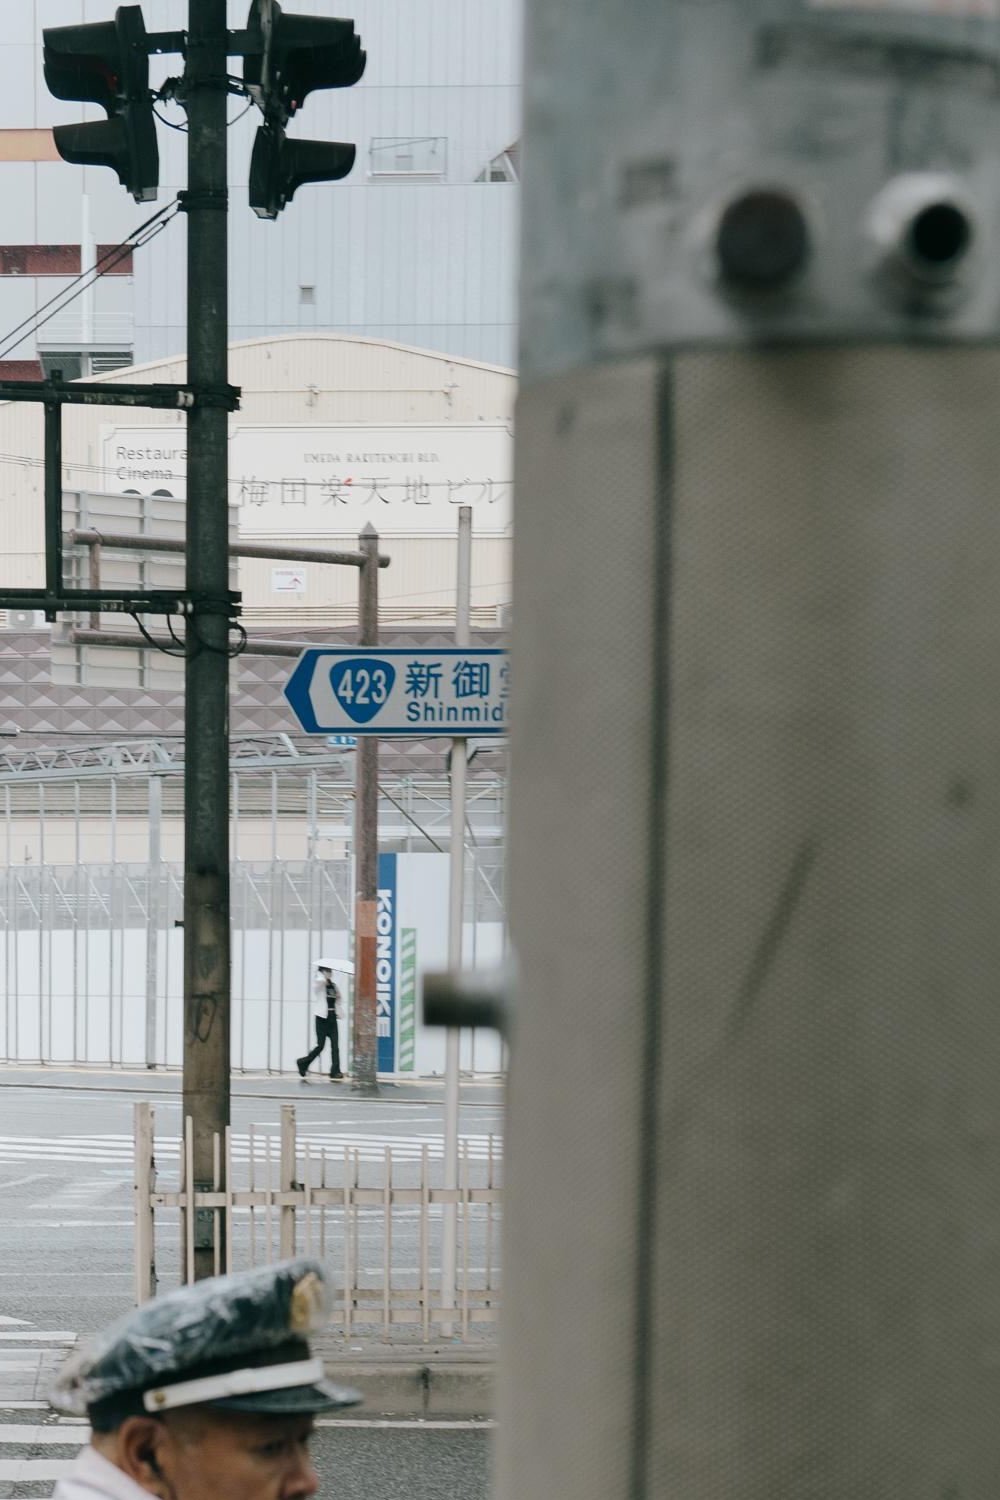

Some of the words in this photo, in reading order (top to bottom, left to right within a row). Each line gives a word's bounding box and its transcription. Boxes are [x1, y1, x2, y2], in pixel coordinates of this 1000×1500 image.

[115, 446, 188, 460] Restaura
[303, 453, 341, 464] UMEDA
[115, 466, 174, 480] Cinema
[238, 474, 507, 508] 梅田楽天地ビル
[337, 668, 388, 705] 423
[406, 701, 510, 722] Shinmid
[376, 889, 393, 1038] KONOIKE
